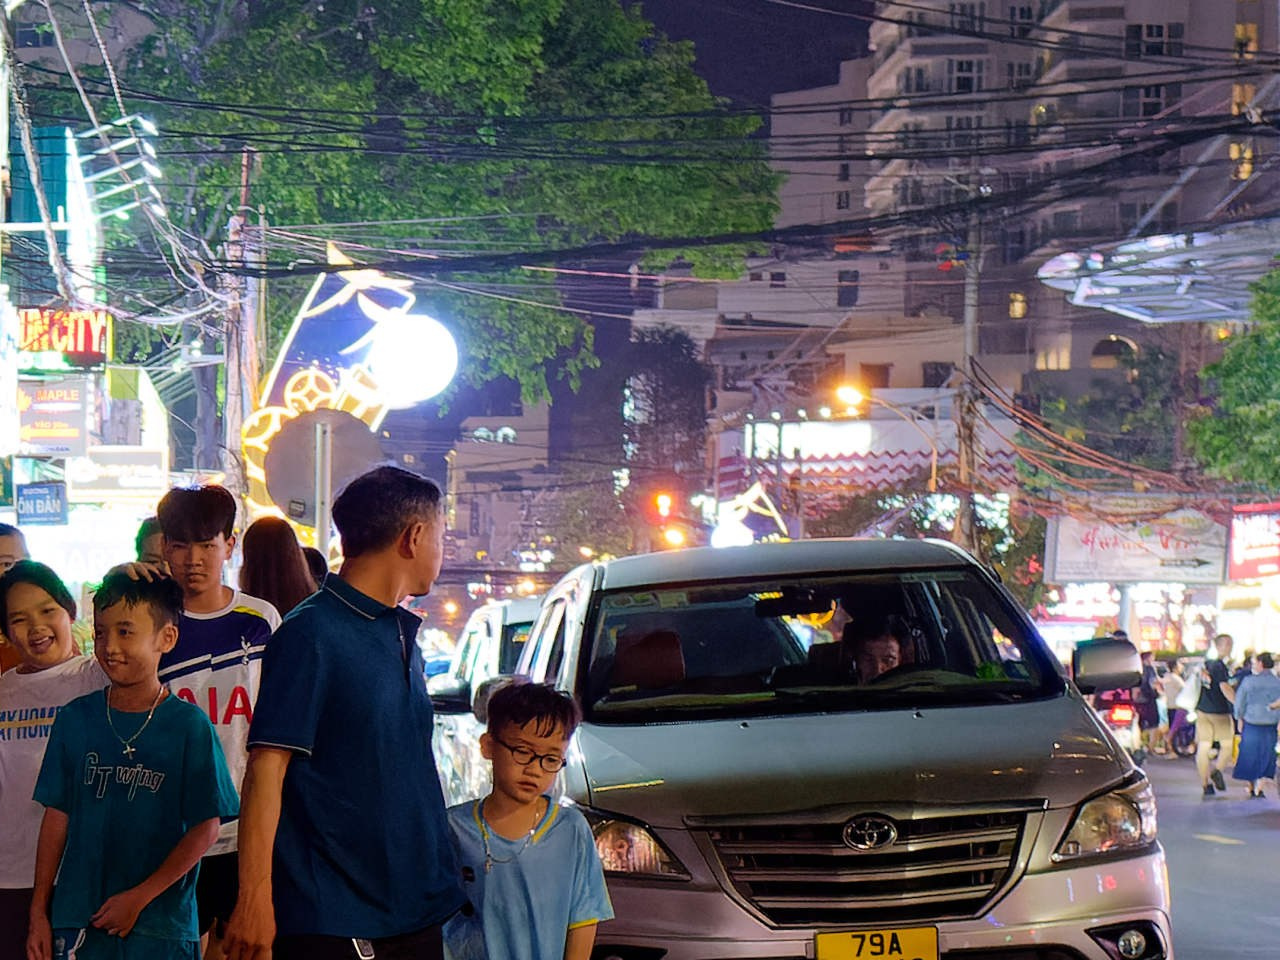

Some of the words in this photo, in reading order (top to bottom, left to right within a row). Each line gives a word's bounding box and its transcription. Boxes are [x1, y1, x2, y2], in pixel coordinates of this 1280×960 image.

[52, 310, 107, 352] CITY
[36, 389, 79, 401] MAPLE
[851, 933, 903, 957] 79A
